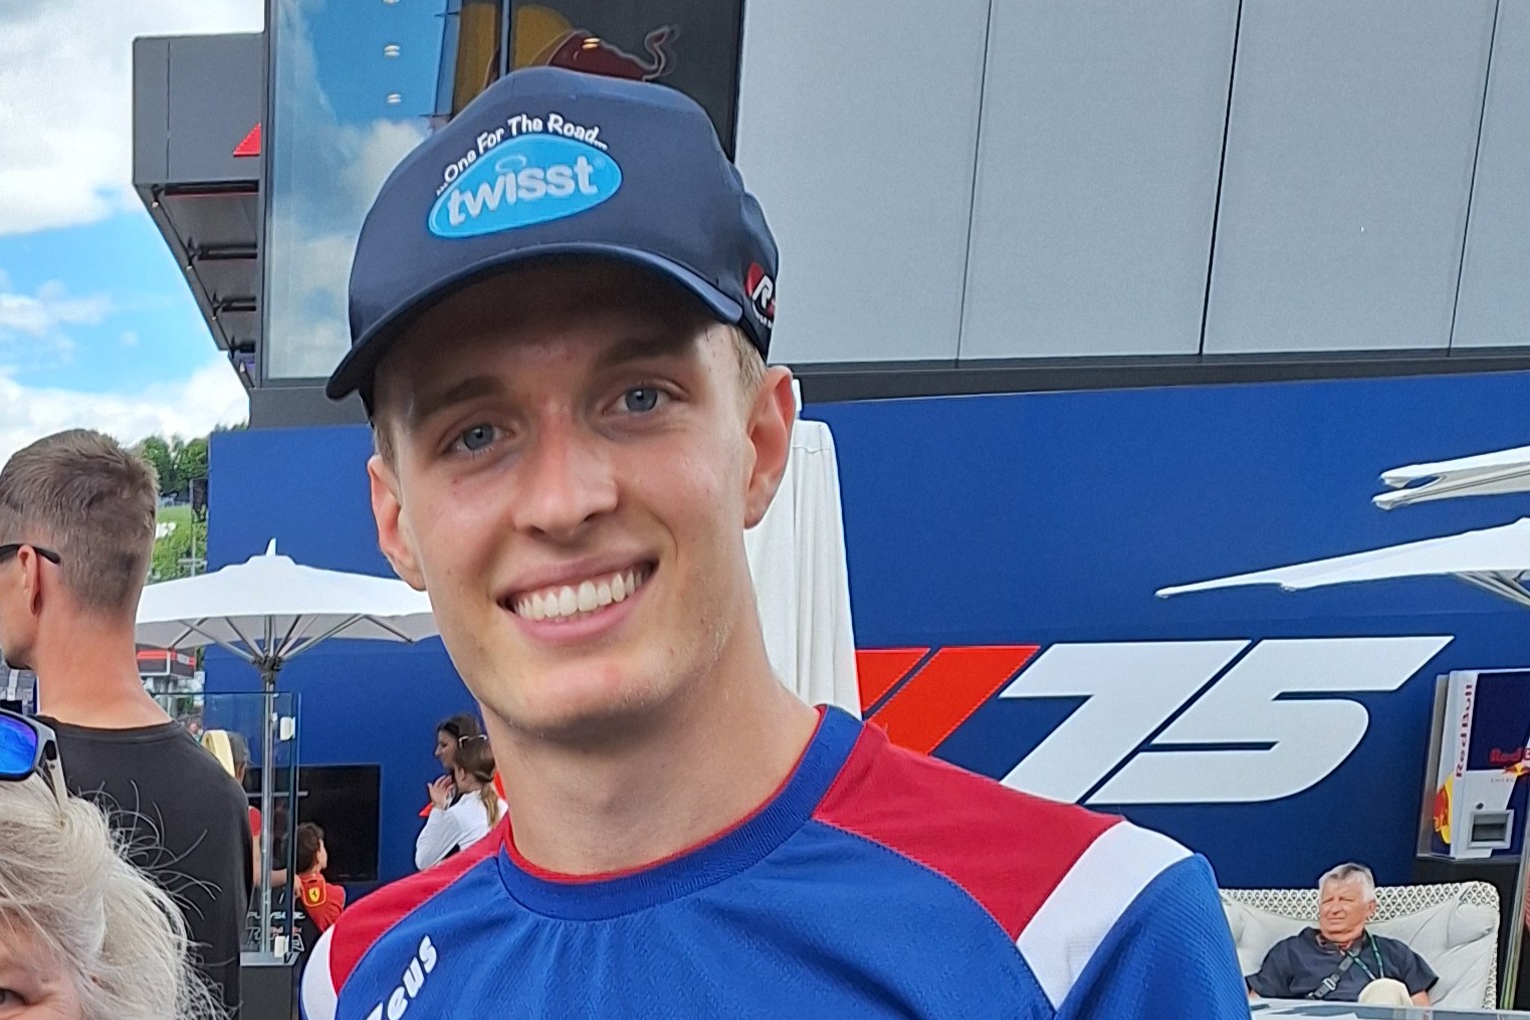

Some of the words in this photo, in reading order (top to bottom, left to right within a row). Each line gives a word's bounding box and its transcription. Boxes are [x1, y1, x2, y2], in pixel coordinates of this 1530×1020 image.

[476, 126, 505, 154] For
[507, 114, 543, 136] The
[446, 154, 600, 228] twisst
